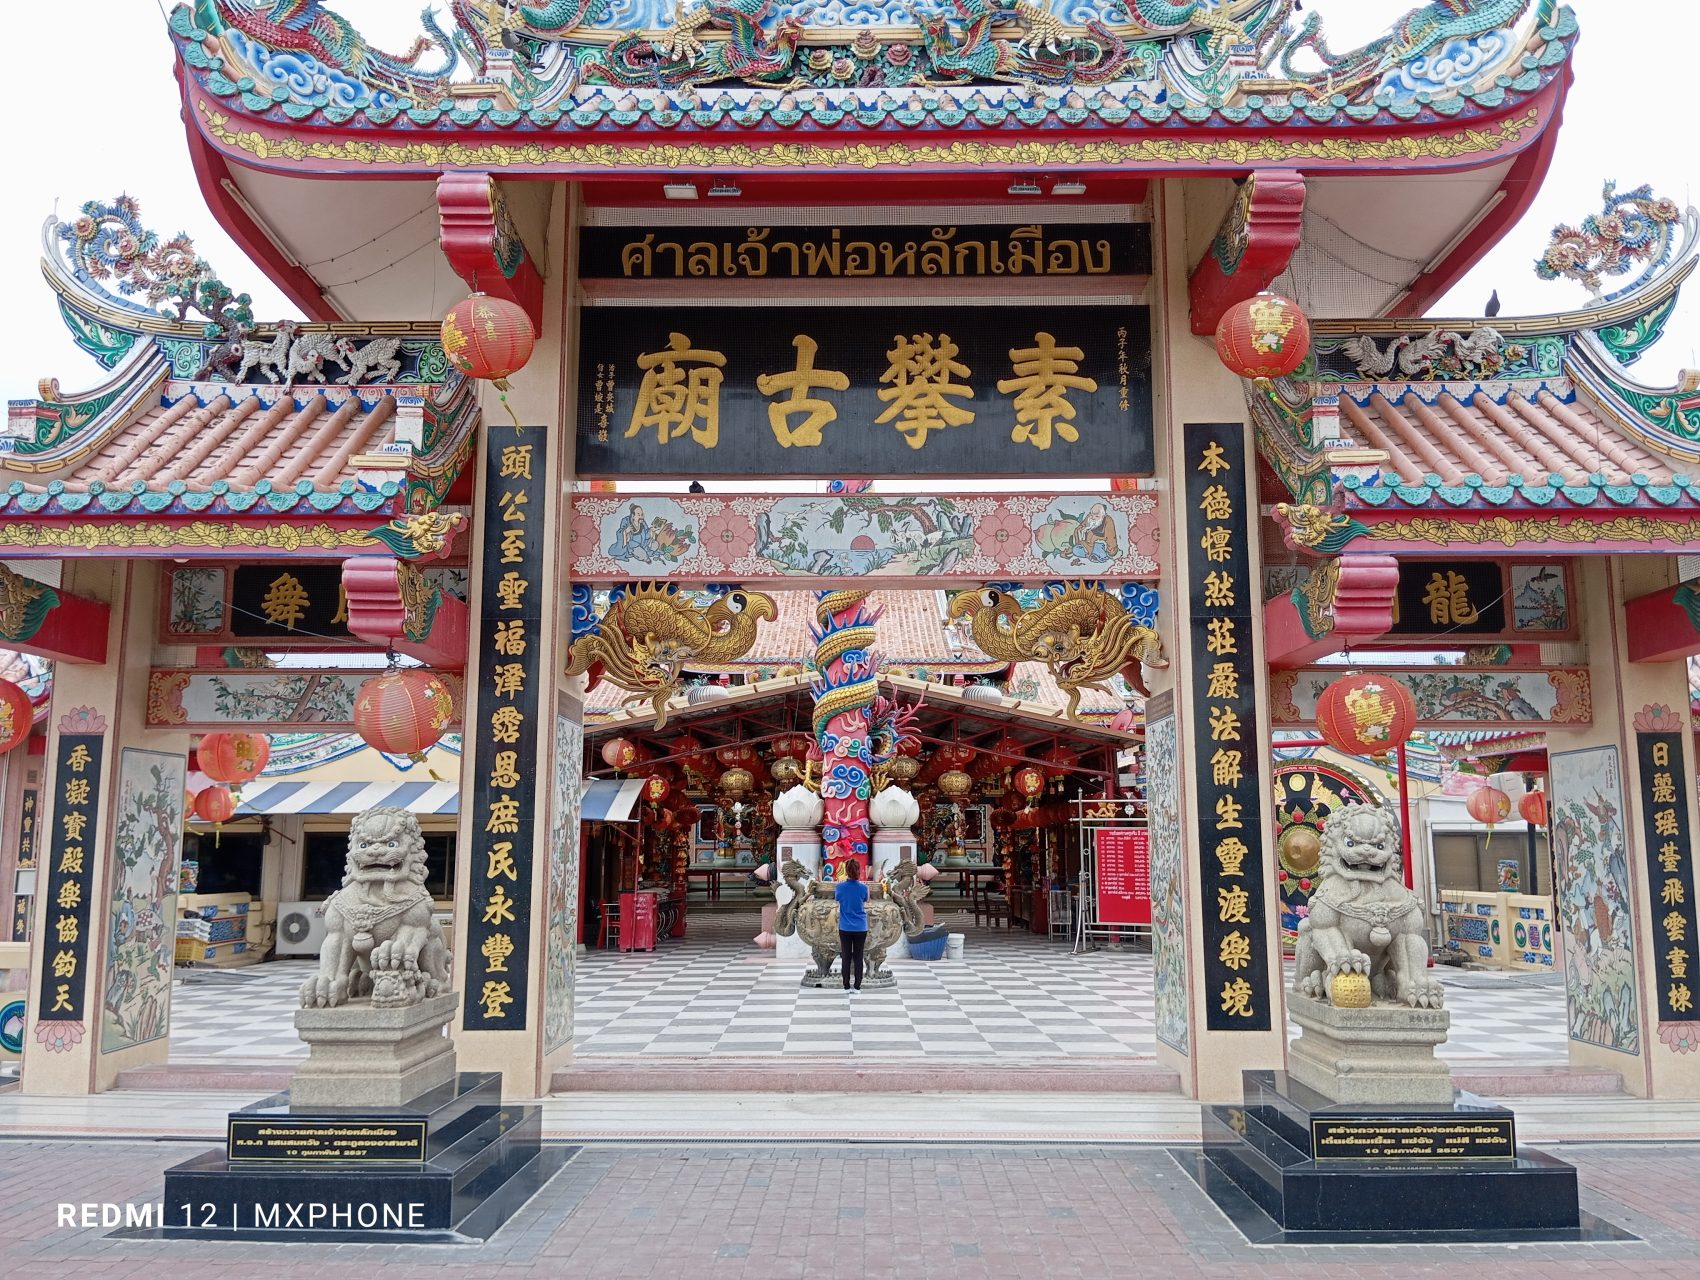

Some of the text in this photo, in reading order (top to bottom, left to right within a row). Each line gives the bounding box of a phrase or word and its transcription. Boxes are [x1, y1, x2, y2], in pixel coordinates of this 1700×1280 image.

[621, 225, 1112, 276] ศาลเจ้าพ่อหลักเมือง
